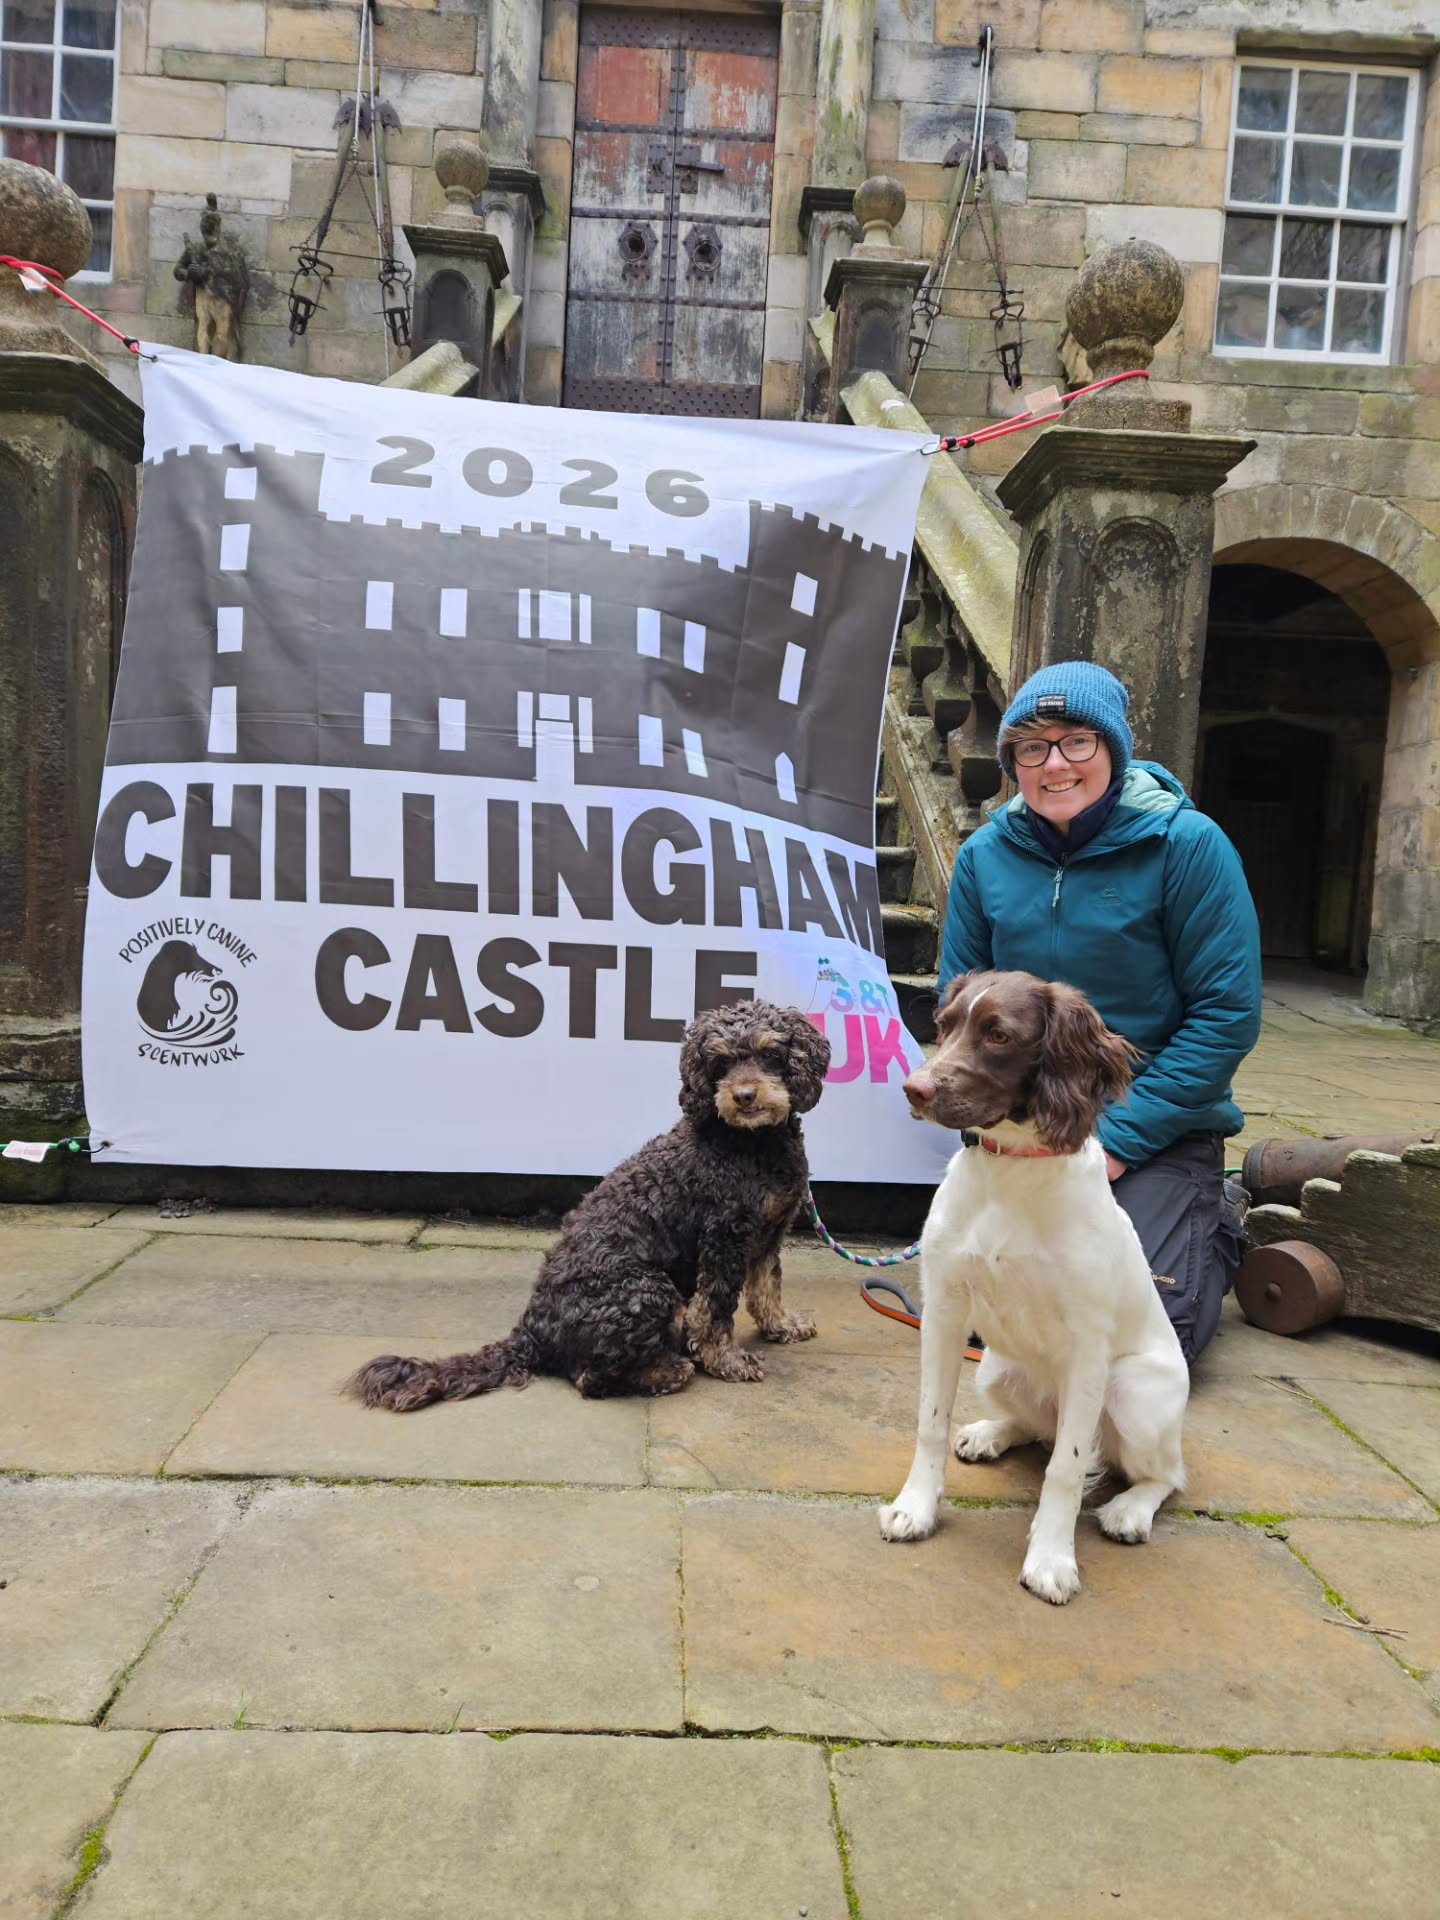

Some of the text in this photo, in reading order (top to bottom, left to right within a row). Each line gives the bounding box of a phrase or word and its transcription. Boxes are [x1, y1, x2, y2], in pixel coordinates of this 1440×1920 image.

[370, 435, 710, 518] 2026
[93, 780, 886, 959] CHILLINGHAM
[118, 917, 258, 968] POSITIVELY CANINE
[314, 927, 758, 1043] CASTLE
[137, 1042, 246, 1068] SCENTWORK
